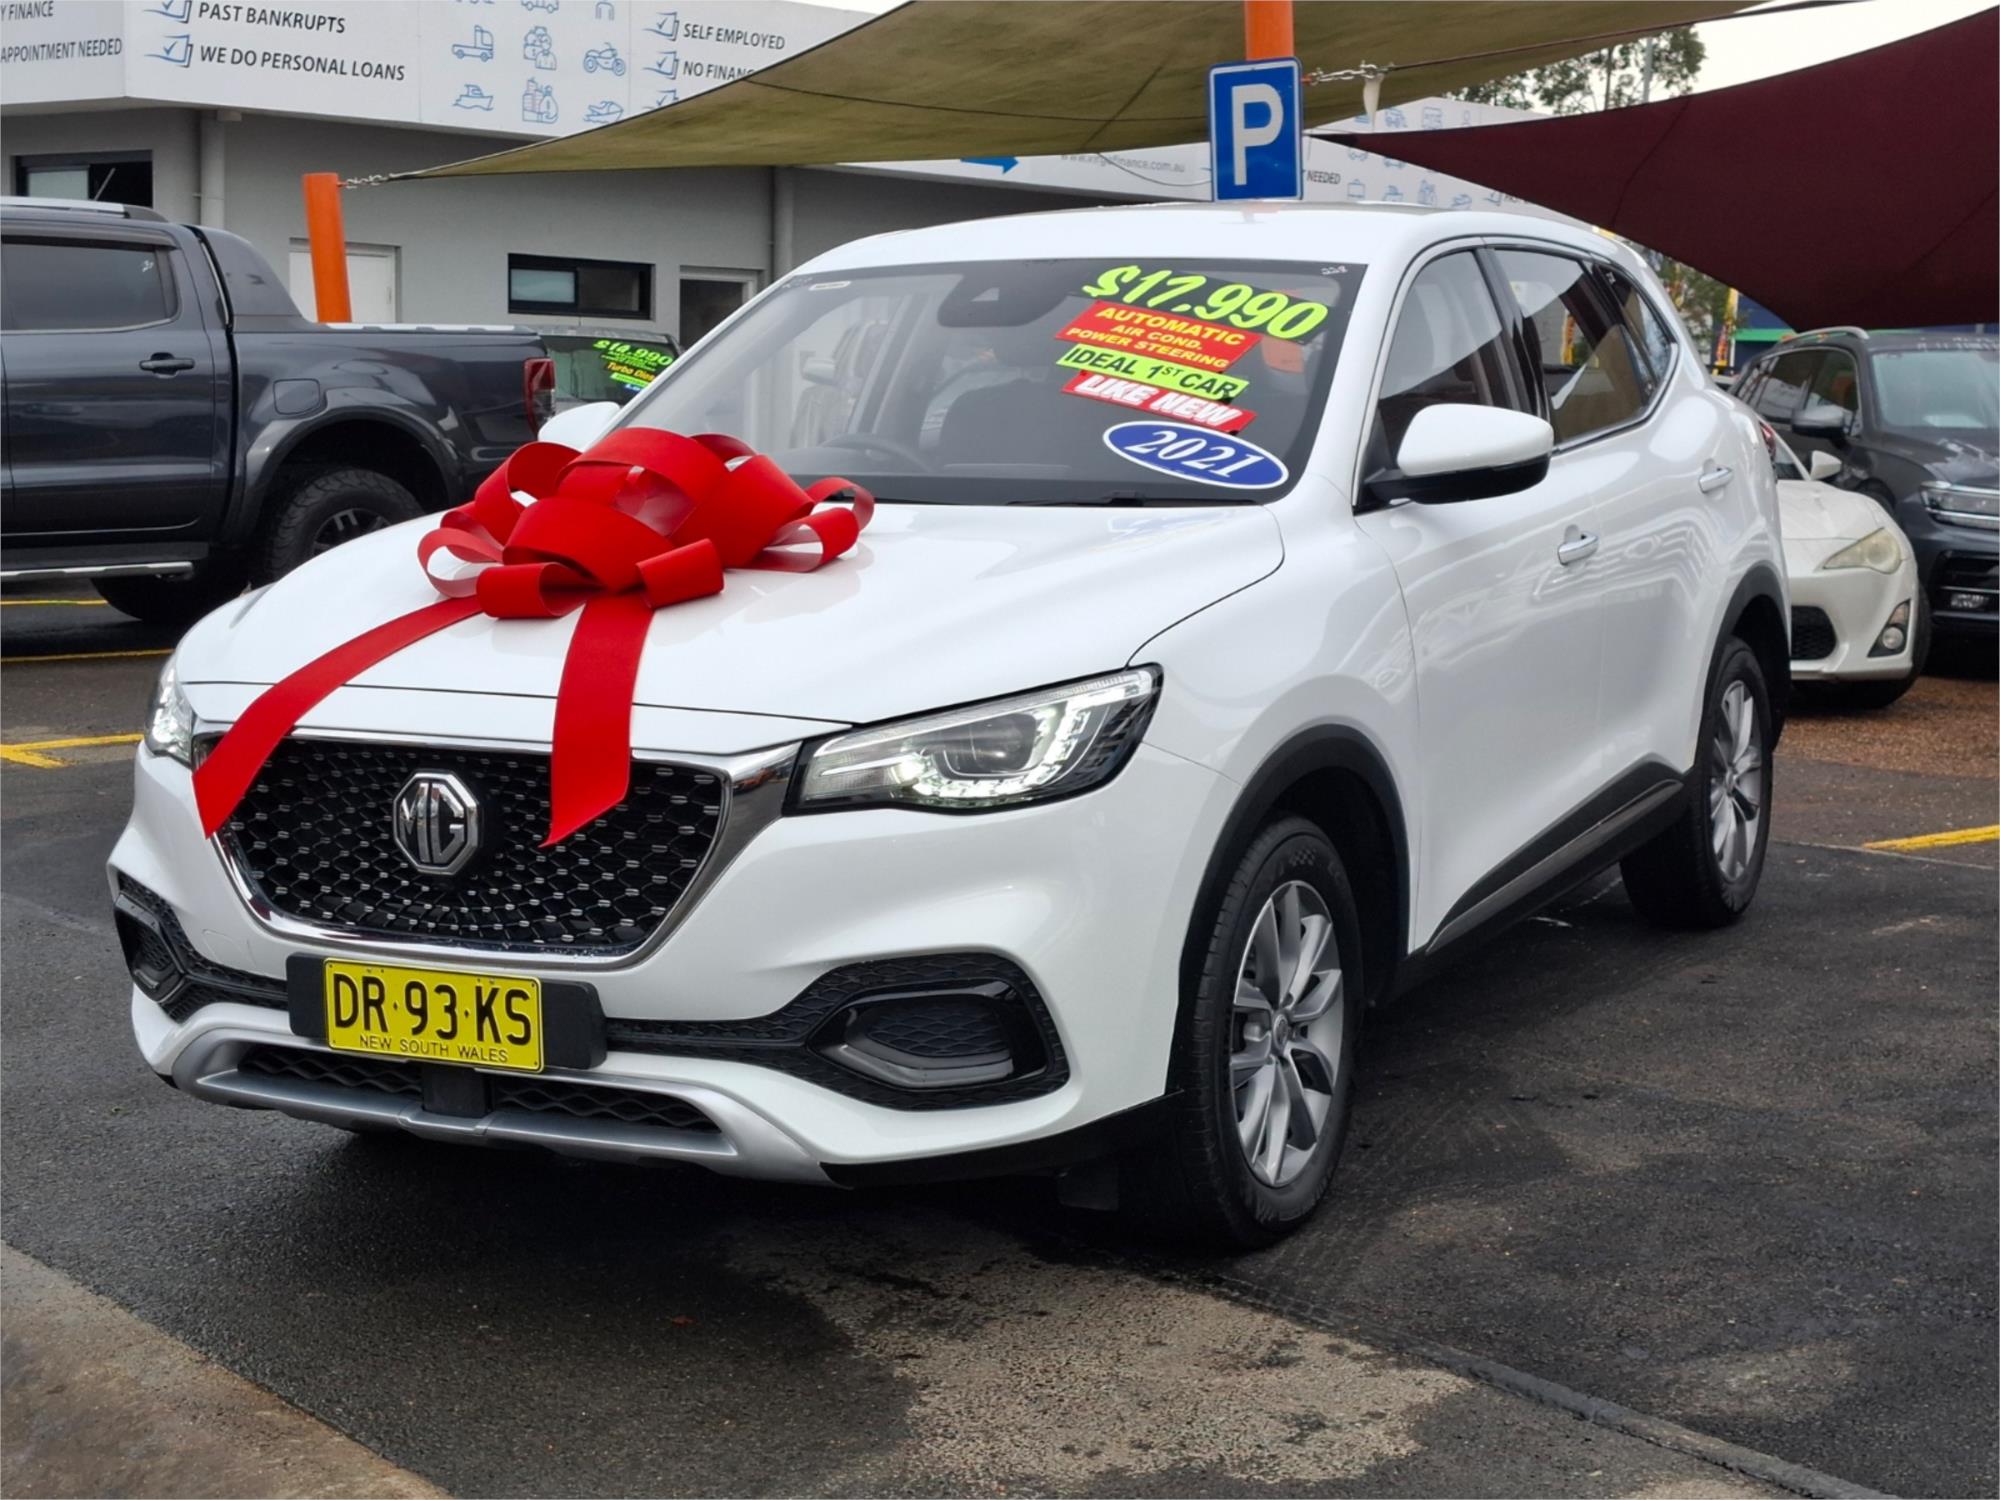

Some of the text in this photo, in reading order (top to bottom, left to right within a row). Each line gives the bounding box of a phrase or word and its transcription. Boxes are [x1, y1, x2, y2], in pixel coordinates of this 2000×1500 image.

[9, 1, 54, 20] FINANCE
[198, 2, 346, 34] PAST BANKRUPTS
[0, 38, 123, 63] APPOINTMENT NEEDED
[683, 23, 785, 50] SELF EMPLOYED
[200, 45, 405, 81] WE DO PERSONAL LOANS
[683, 61, 755, 80] NO FINAN
[1231, 83, 1284, 186] P
[1307, 170, 1341, 184] NEEDED
[1096, 307, 1246, 346] AUTOMATIC
[1111, 324, 1202, 350] AIR COND.
[1067, 327, 1230, 368] POWER STEERING
[1065, 347, 1139, 375] IDEAL
[1179, 373, 1239, 397] CAR
[1074, 374, 1244, 427] LIKE NEW
[1124, 430, 1265, 478] 2021
[400, 782, 465, 863] MG
[360, 1034, 508, 1063] NEW SOUTH WALES
